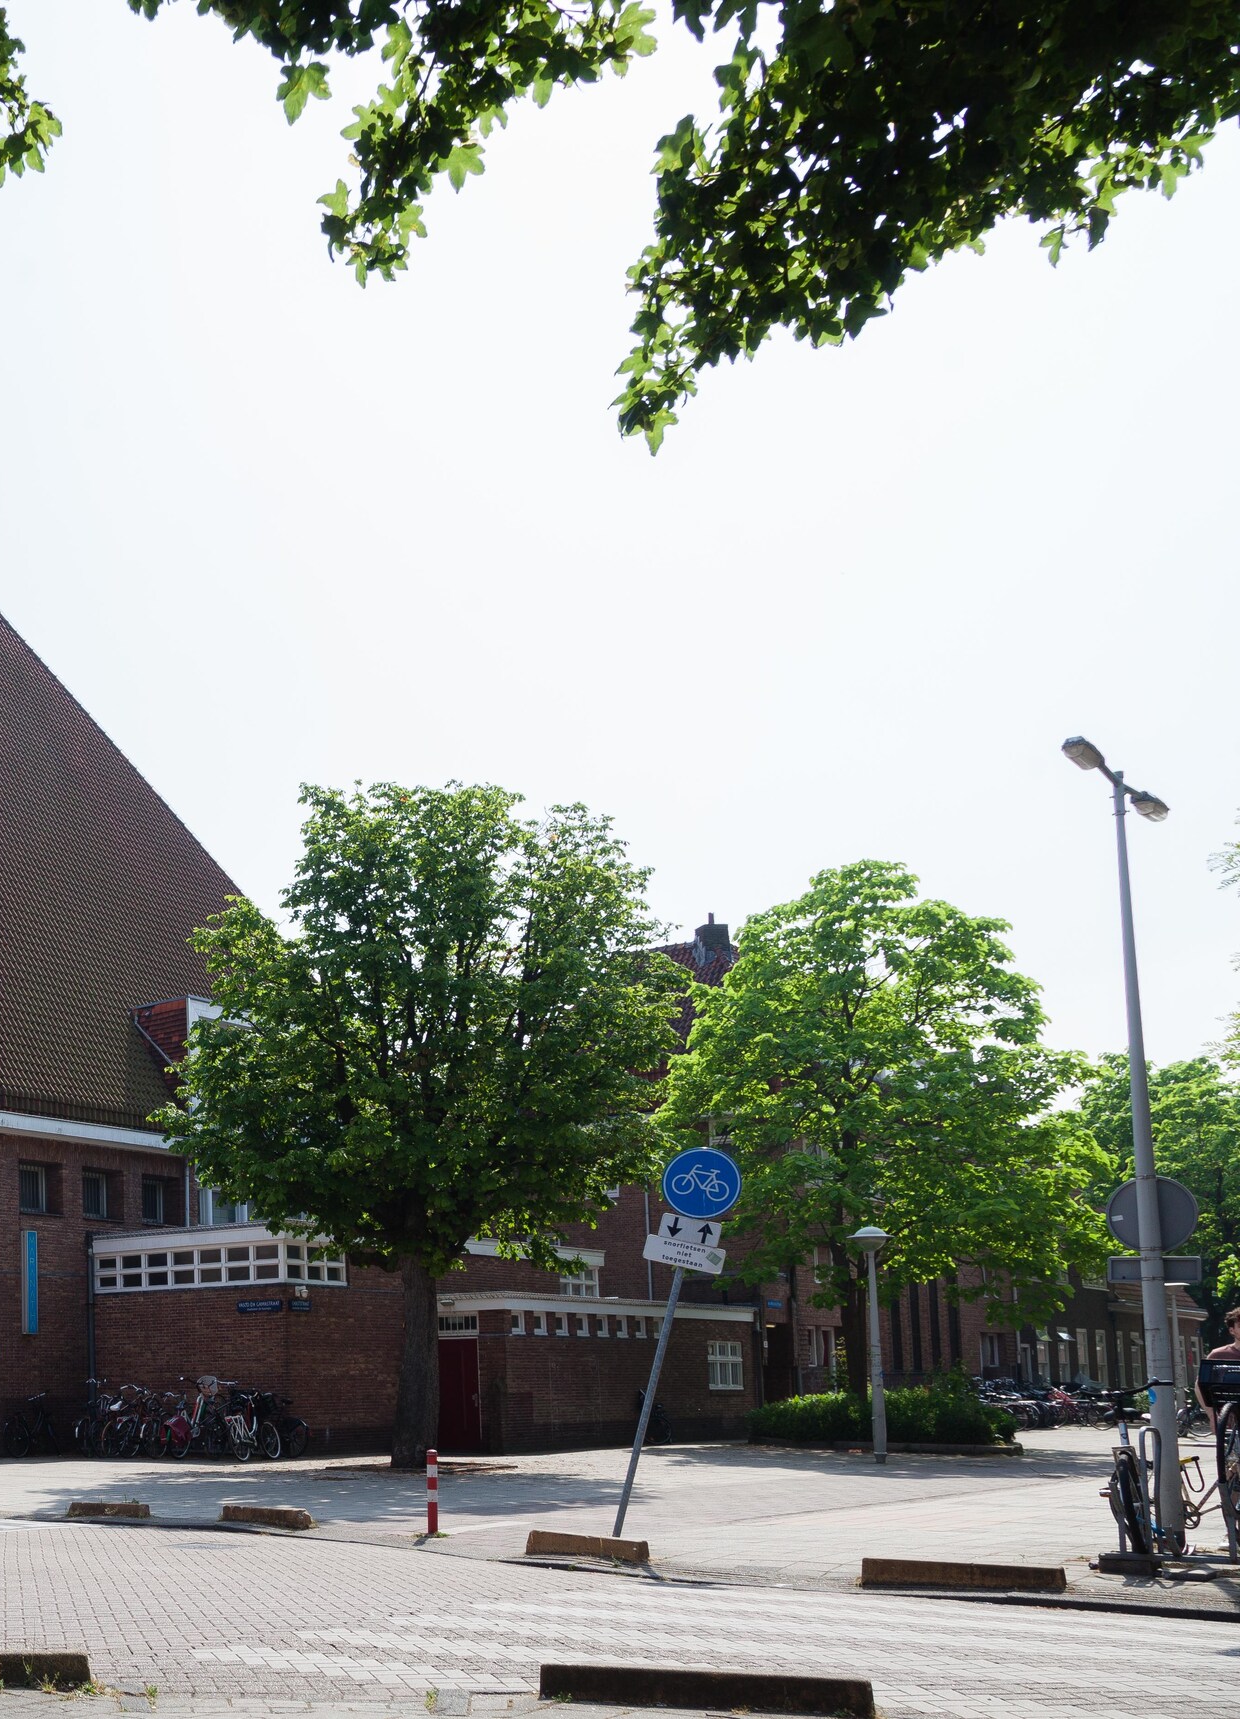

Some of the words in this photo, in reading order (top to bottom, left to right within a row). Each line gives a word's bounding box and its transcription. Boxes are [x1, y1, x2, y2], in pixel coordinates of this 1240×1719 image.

[663, 1240, 706, 1253] snorfietsen
[677, 1250, 692, 1258] niet
[662, 1254, 703, 1268] toegestaan
